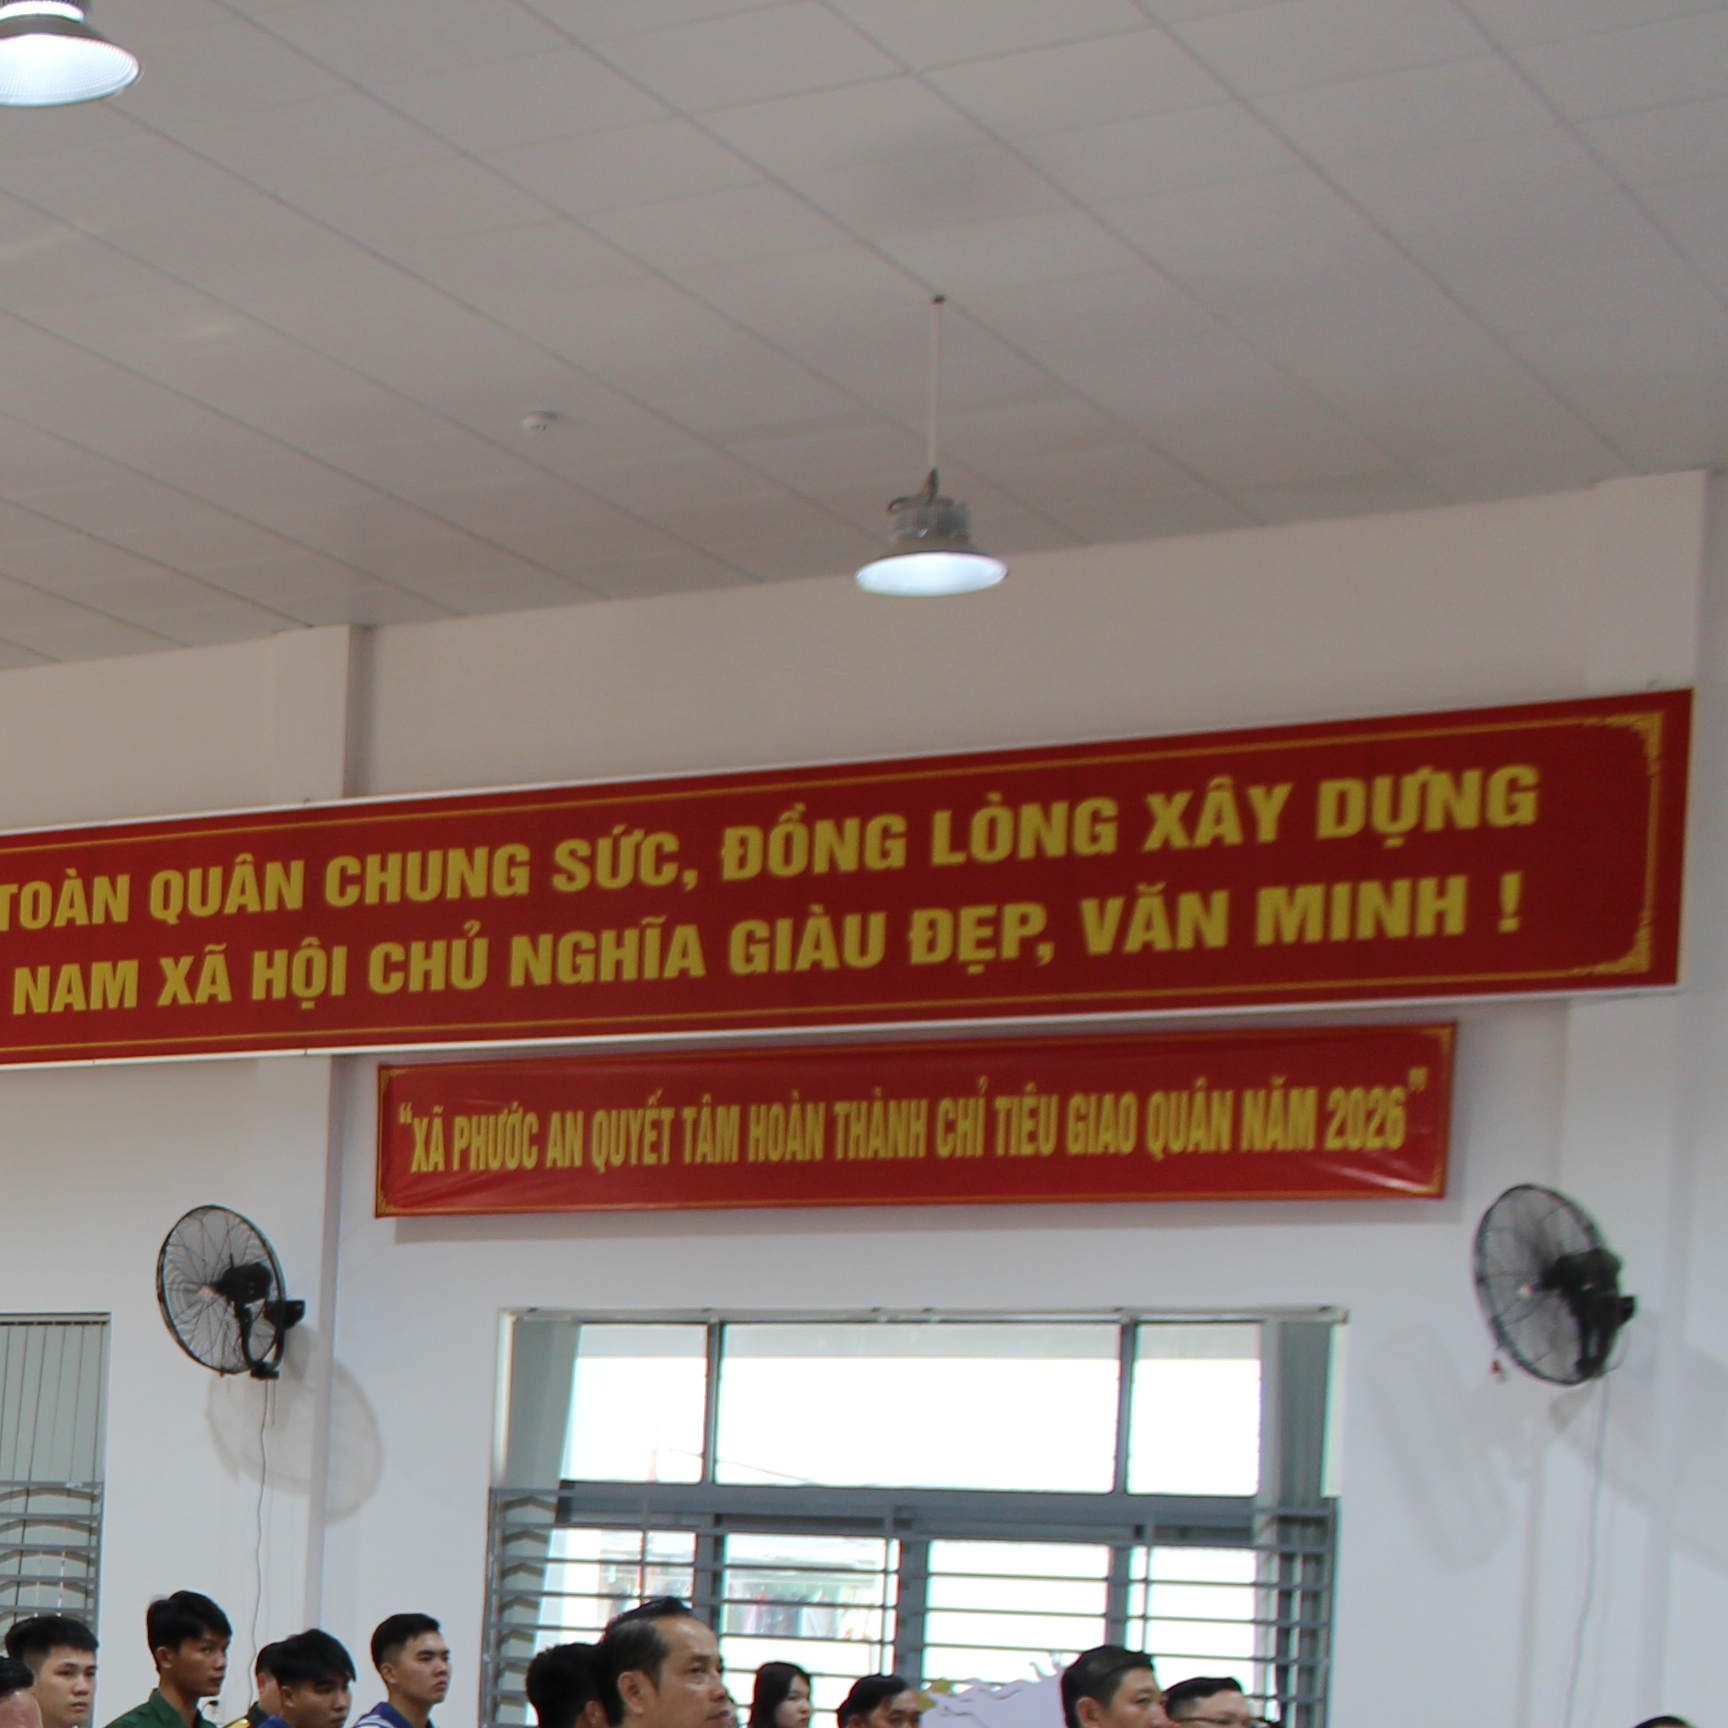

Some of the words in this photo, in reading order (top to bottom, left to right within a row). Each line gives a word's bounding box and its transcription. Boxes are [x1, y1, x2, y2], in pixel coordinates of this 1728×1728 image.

[149, 853, 304, 925] QUÂN
[324, 844, 530, 908] CHUNG
[551, 825, 697, 893] SỨC,
[720, 804, 906, 881] ĐỒNG
[931, 792, 1117, 866] LÒNG
[1143, 776, 1292, 851] XÂY
[1316, 765, 1538, 848] DỰNG
[12, 960, 139, 1015] NAM
[157, 944, 232, 1006] XÃ
[251, 936, 347, 1010] HỘI
[368, 920, 488, 994] CHỦ
[509, 916, 706, 987] NGHĨA
[728, 904, 886, 975] GIÀU
[908, 903, 1053, 974] ĐẸP,
[1080, 883, 1229, 955] VĂN
[1256, 875, 1467, 945] MINH
[1499, 872, 1521, 932] !
[452, 1102, 539, 1172] PHƯỚC
[544, 1111, 584, 1168] AN
[590, 1090, 675, 1173] QUYẾT
[681, 1094, 740, 1164] TÂM
[747, 1091, 825, 1162] HOÀN
[833, 1088, 928, 1160] THÀNH
[935, 1077, 986, 1158] CHỈ
[994, 1083, 1058, 1156] TIÊU
[1065, 1092, 1137, 1155] GIAO
[1145, 1078, 1233, 1160] QUÂN
[1240, 1077, 1318, 1151] NĂM
